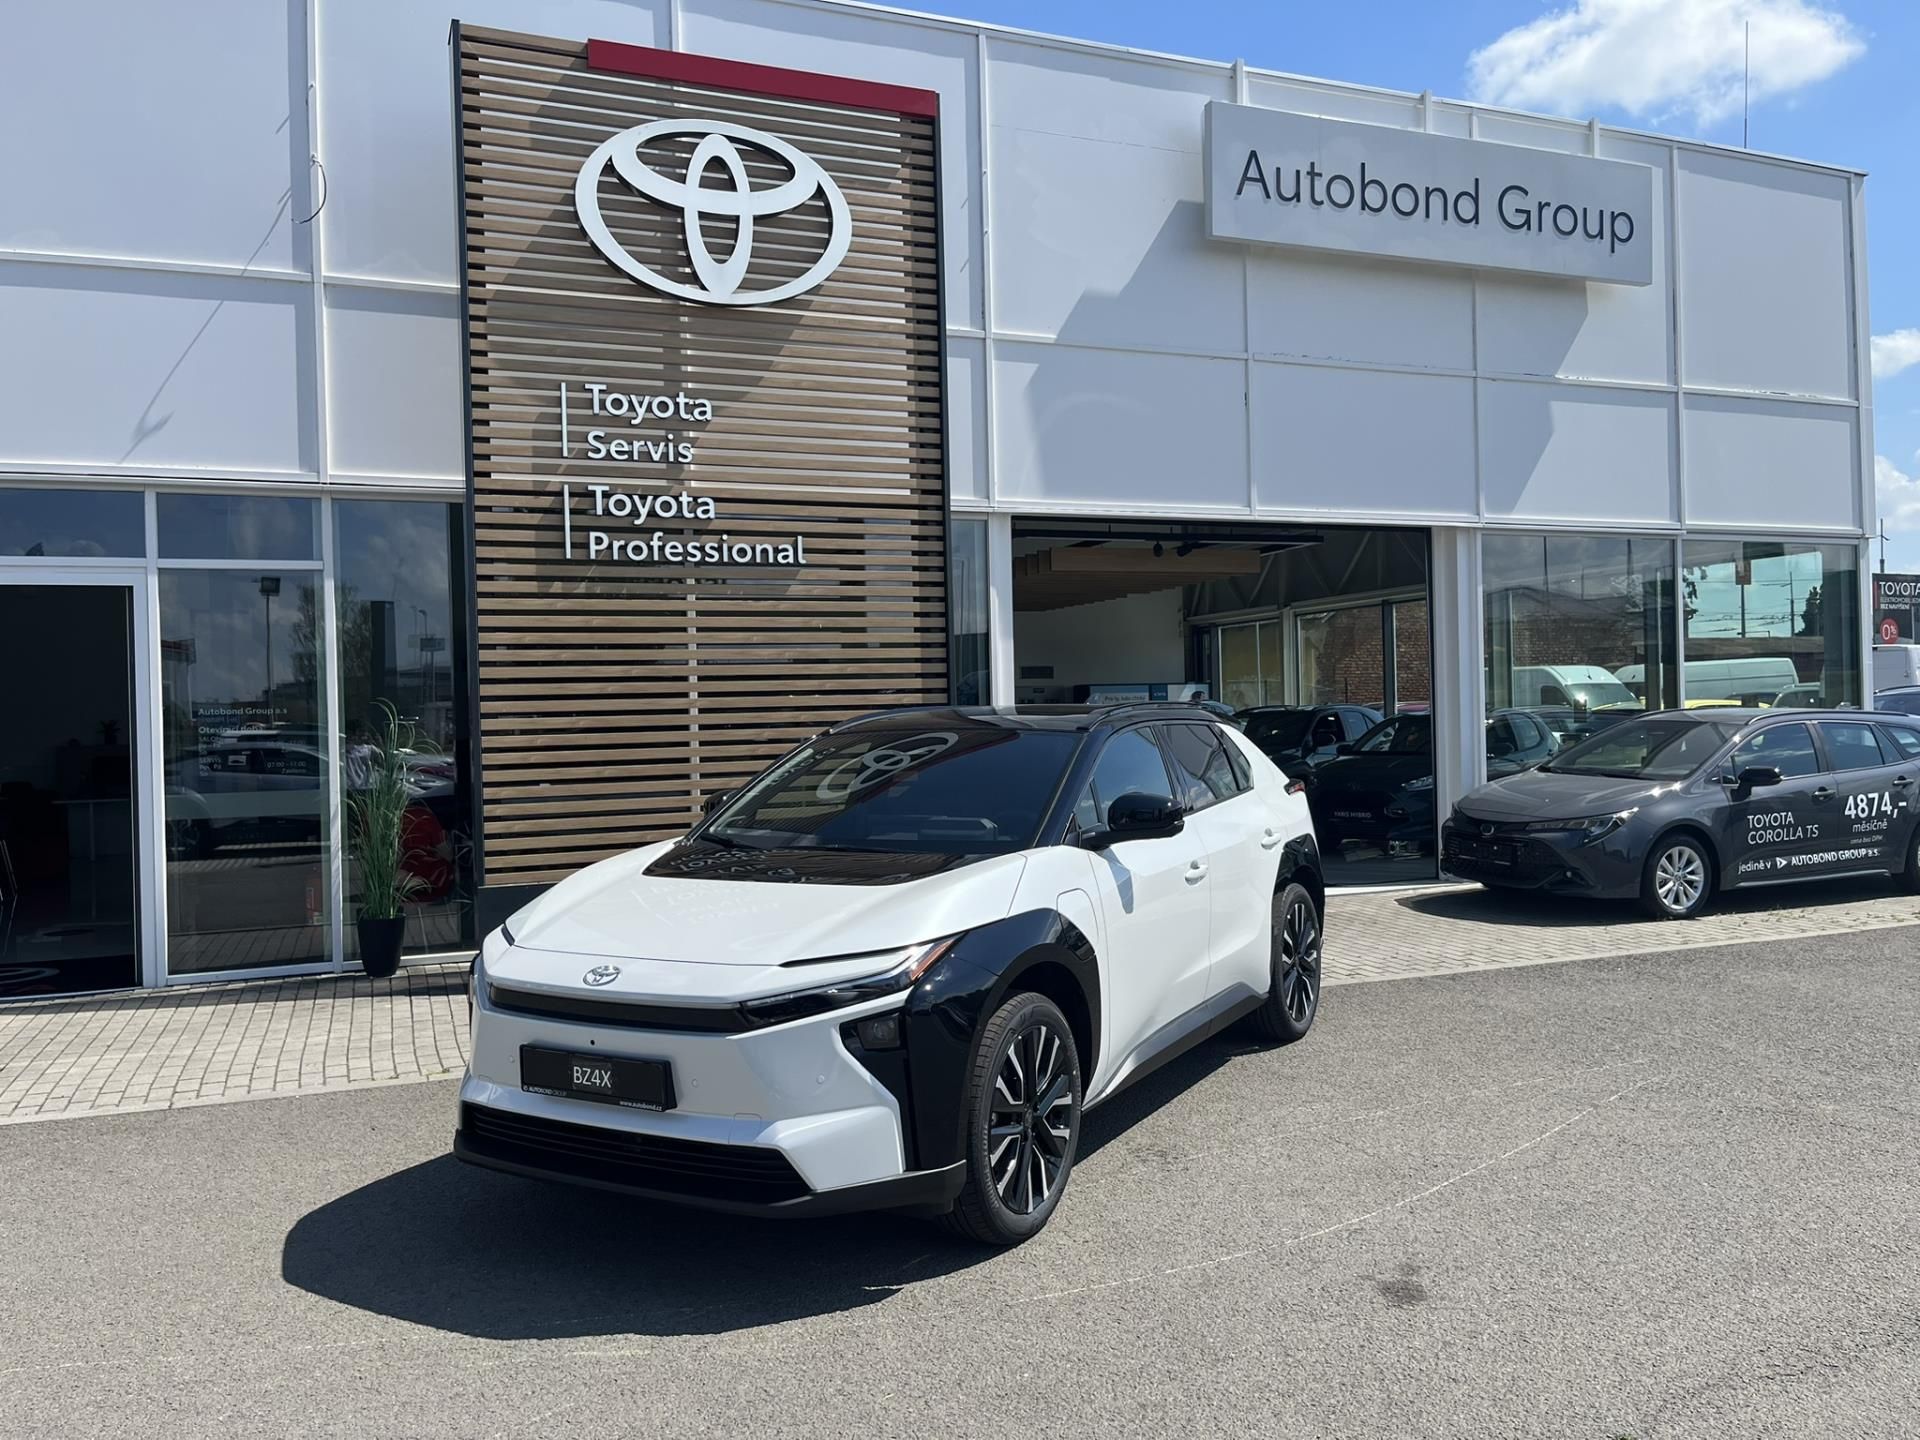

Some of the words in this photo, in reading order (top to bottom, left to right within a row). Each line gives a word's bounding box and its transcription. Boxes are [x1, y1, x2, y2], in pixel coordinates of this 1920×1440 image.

[1235, 149, 1481, 226] Autobond
[1497, 184, 1635, 254] Group
[584, 383, 714, 425] Toyota
[587, 430, 694, 463] Servis
[587, 485, 716, 526] Toyota
[588, 531, 807, 564] Professional
[198, 707, 244, 716] Autobond
[245, 707, 274, 717] Group
[1844, 791, 1907, 819] 4874,-
[1747, 812, 1794, 829] TOYOTA
[1852, 818, 1888, 833] měsíčně
[1747, 827, 1804, 845] COROLLA
[1806, 825, 1819, 838] TS
[1737, 859, 1765, 875] jedině
[1765, 861, 1771, 870] v
[1791, 851, 1838, 867] AUTOBOND
[1838, 848, 1867, 861] GROUP
[573, 1066, 612, 1088] BZ4X
